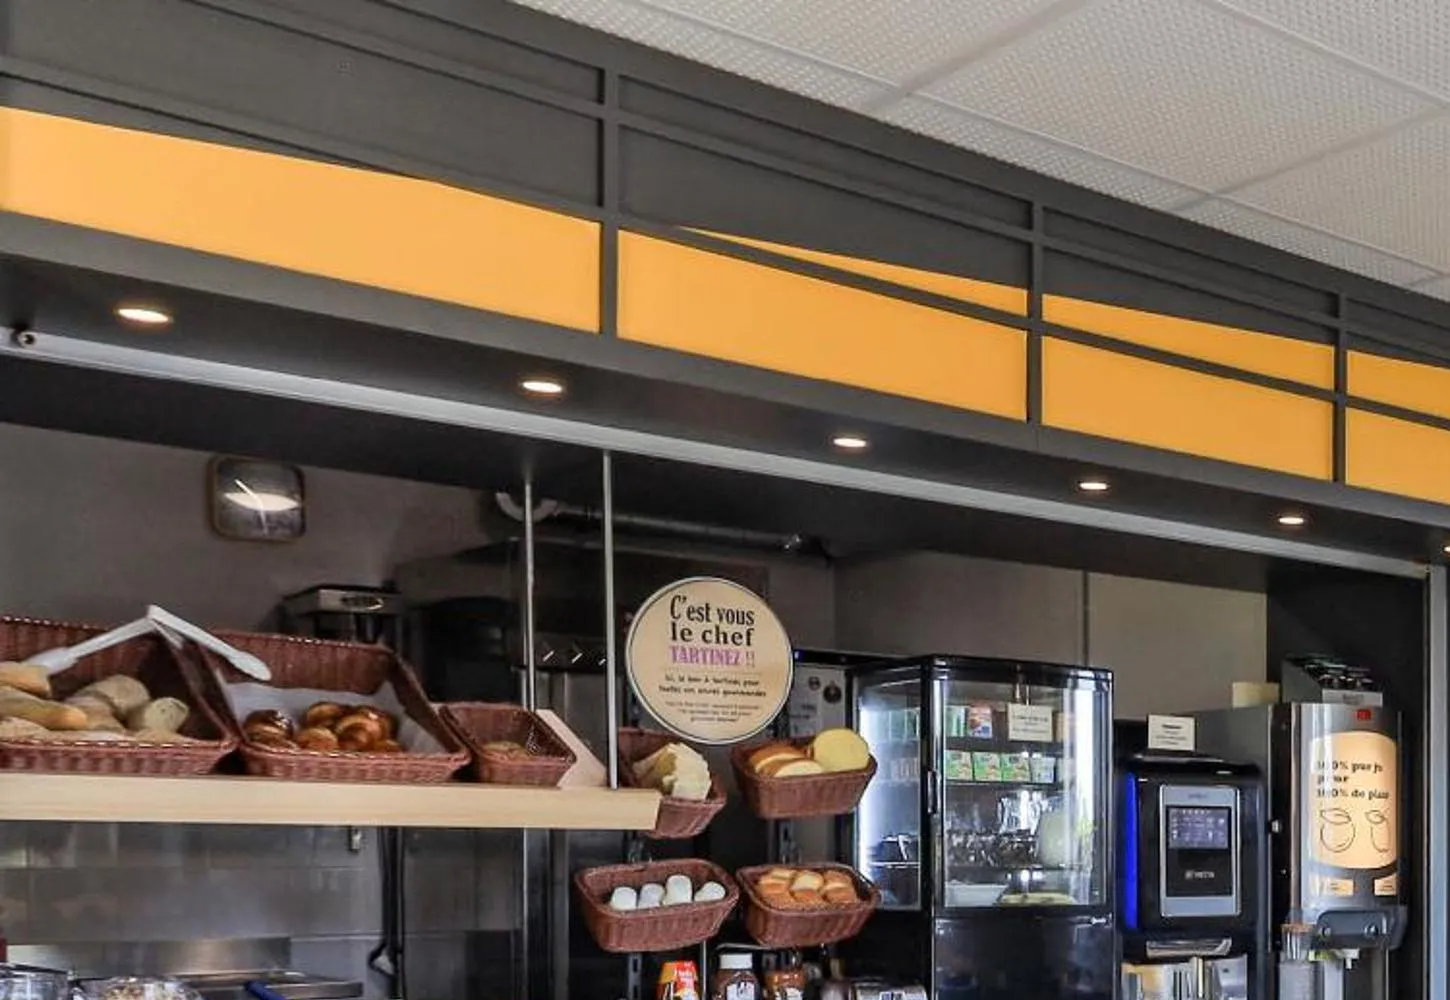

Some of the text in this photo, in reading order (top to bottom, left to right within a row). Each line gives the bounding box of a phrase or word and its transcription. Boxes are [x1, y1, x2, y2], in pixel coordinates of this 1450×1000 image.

[670, 595, 755, 626] C'est vous
[671, 621, 755, 647] le chef
[669, 645, 740, 666] TARTINEZ
